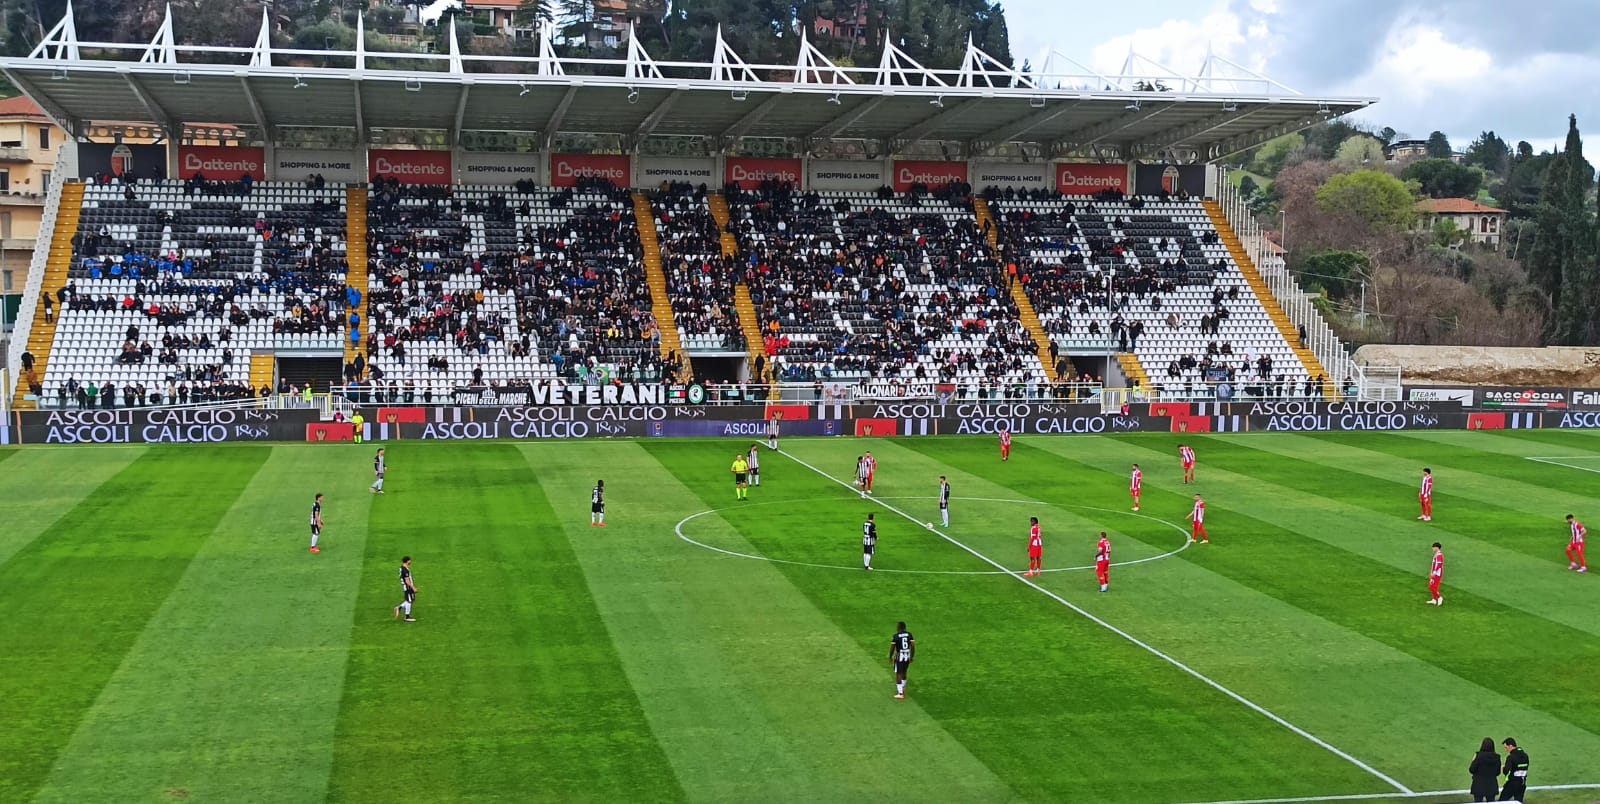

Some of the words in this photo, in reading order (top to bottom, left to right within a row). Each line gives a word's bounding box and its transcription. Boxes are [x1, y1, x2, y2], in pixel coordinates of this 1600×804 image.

[185, 153, 257, 171] Battente
[280, 161, 319, 169] SHOPPING
[328, 162, 351, 170] MORE
[376, 157, 445, 175] Battente
[467, 165, 505, 173] SHOPPING
[816, 172, 851, 180] SHOPPING
[1062, 170, 1122, 186] Battente
[456, 393, 479, 404] PICENI
[499, 393, 528, 405] MARCHE
[530, 384, 666, 405] VETERANI
[852, 384, 899, 400] PALLONARI
[904, 384, 936, 396] ASCOLI
[1485, 391, 1564, 400] SACCOCCIA
[496, 407, 574, 421] ASCOLI
[587, 406, 667, 421] CALCIO
[674, 406, 706, 418] 1898
[873, 404, 945, 418] ASCOLI
[956, 404, 1030, 418] CALCIO
[1038, 403, 1067, 414] 1898
[1249, 402, 1317, 415] ASCOLI
[1327, 401, 1397, 415] CALCIO
[1403, 401, 1430, 412] 1898
[46, 410, 133, 425] ASCOLI
[147, 410, 235, 425] CALCIO
[245, 409, 279, 422] 1898
[1266, 415, 1331, 431] ASCOLI
[1340, 414, 1407, 430] CALCIO
[1412, 413, 1439, 426] 1898
[422, 422, 498, 439] ASCOLI
[510, 421, 588, 438] CALCIO
[596, 421, 627, 434] 1898
[724, 423, 767, 434] ASCOLI
[956, 418, 1025, 434] ASCOLI
[1035, 417, 1105, 433] CALCIO
[1112, 416, 1140, 429] 1898
[46, 425, 130, 443] ASCOLI
[142, 425, 227, 442] CALCIO
[236, 424, 269, 438] 1898
[902, 637, 909, 649] 6
